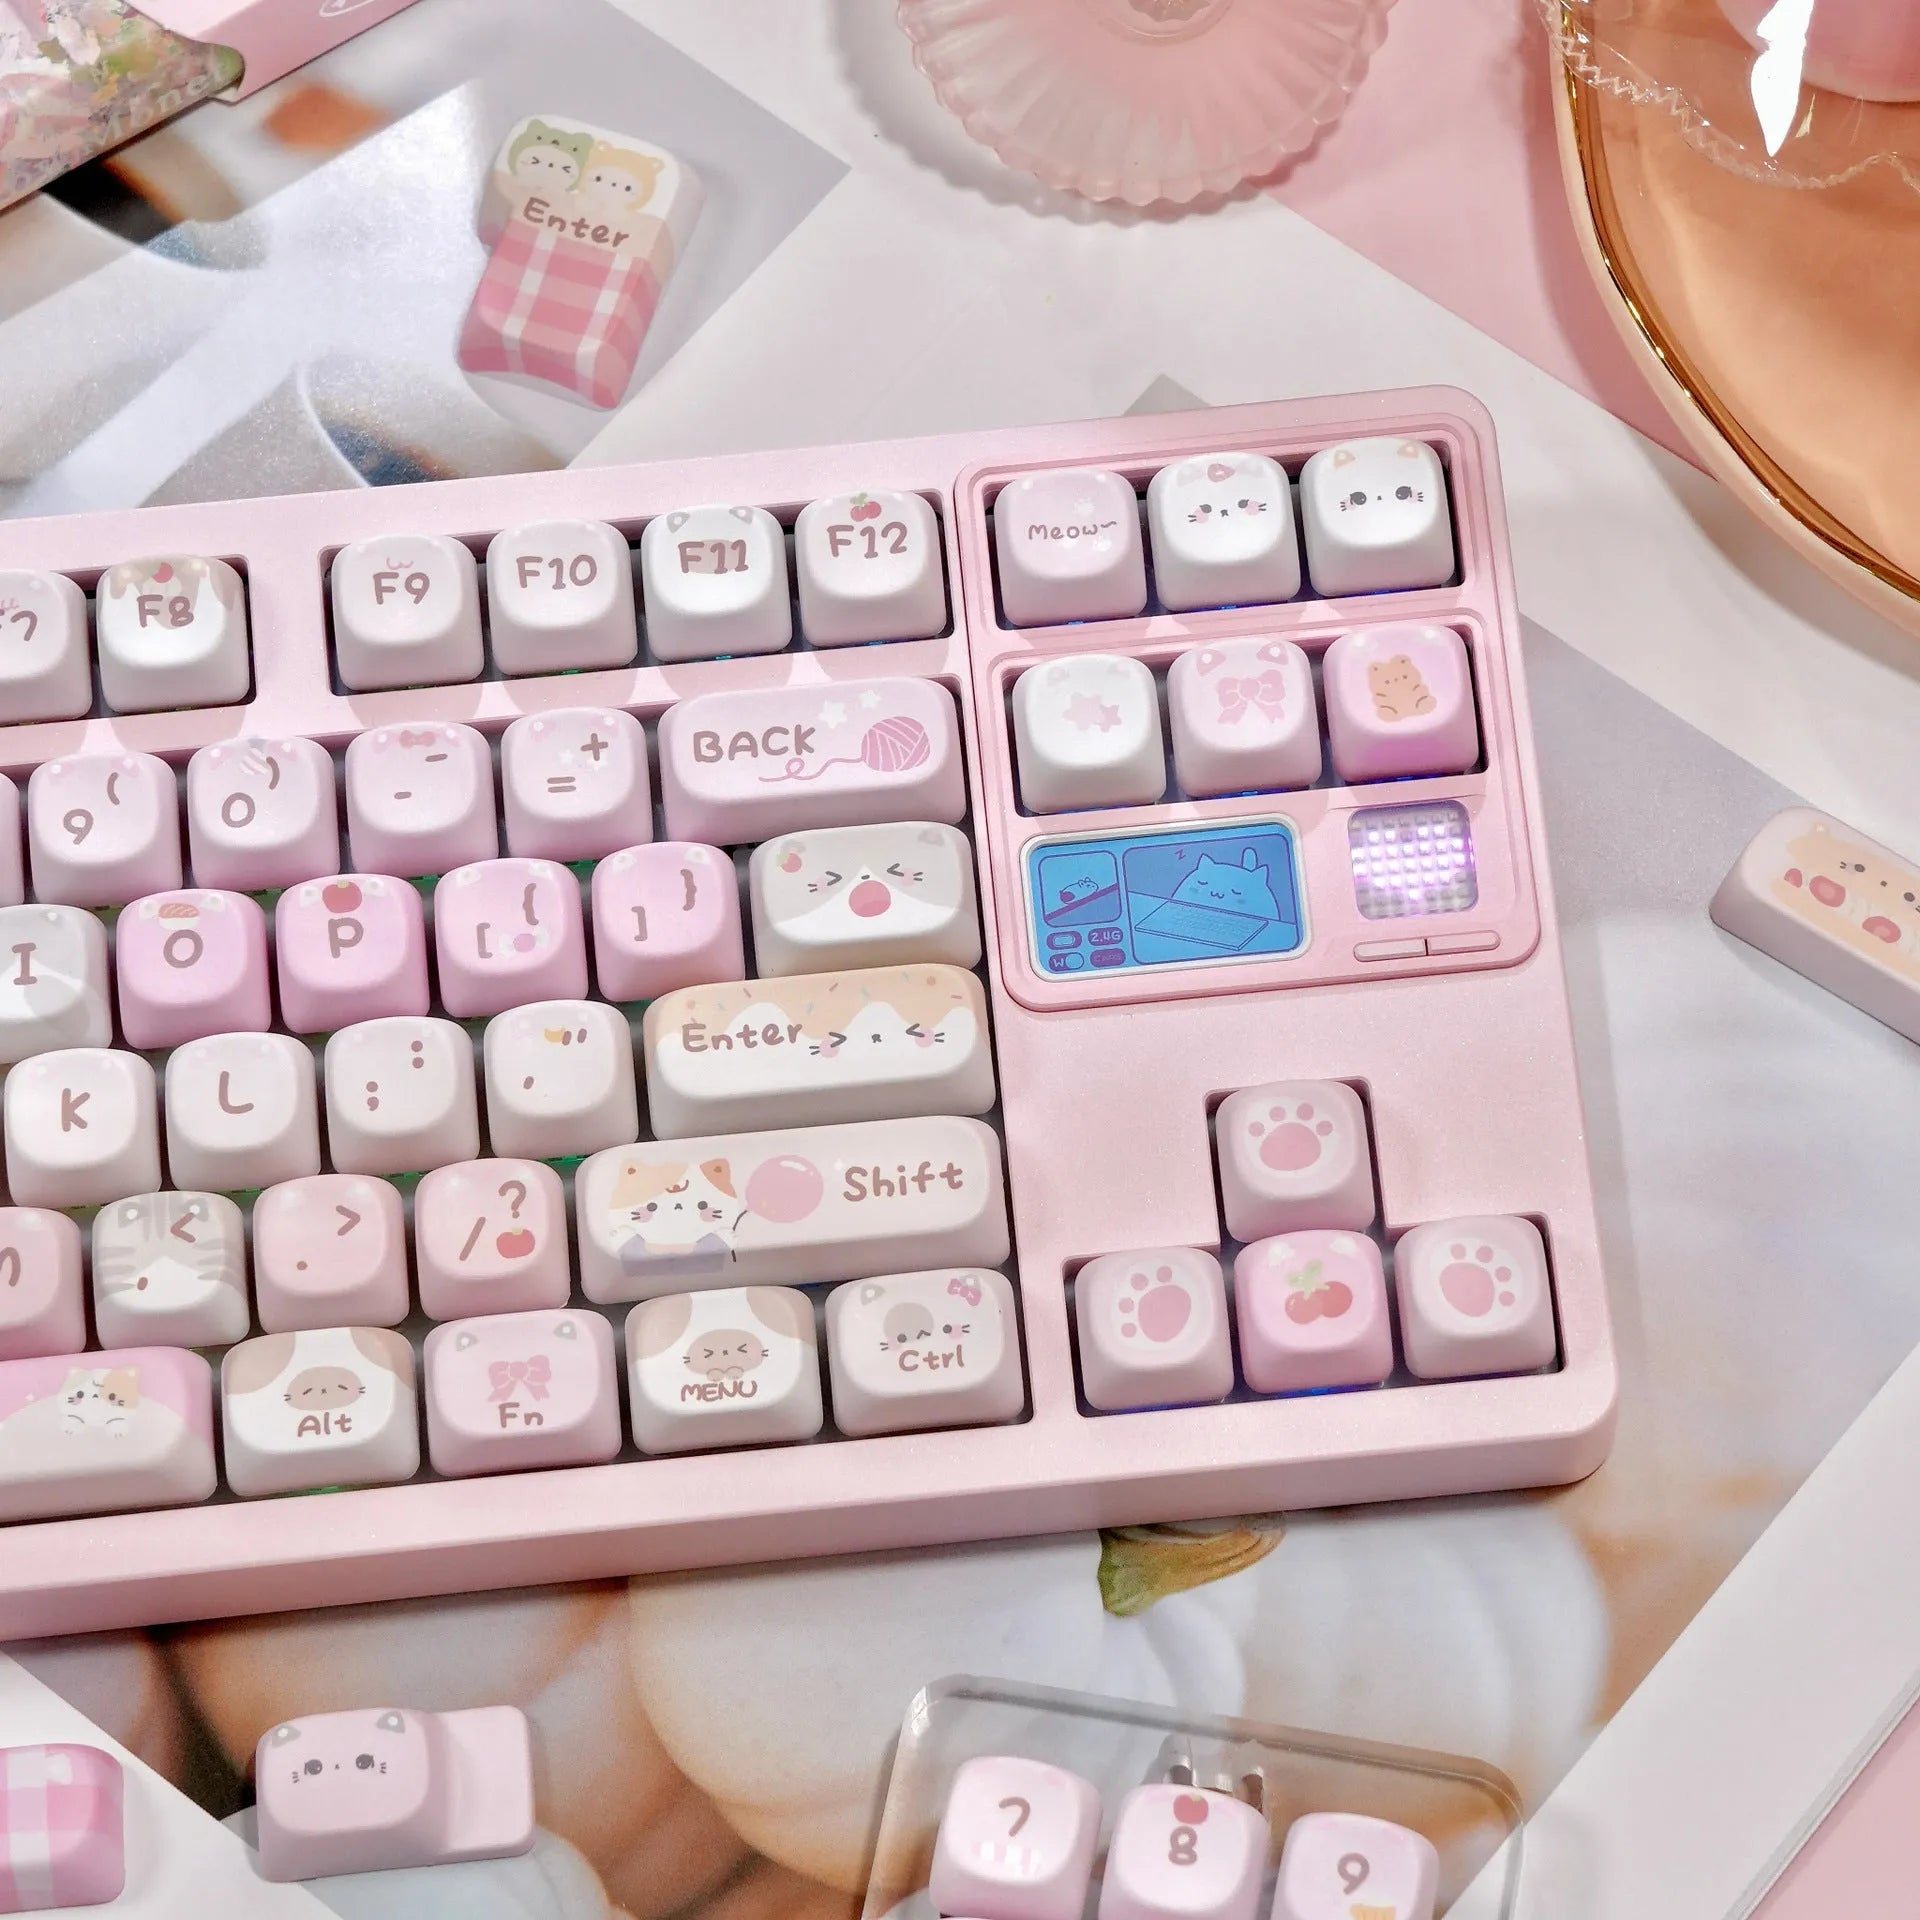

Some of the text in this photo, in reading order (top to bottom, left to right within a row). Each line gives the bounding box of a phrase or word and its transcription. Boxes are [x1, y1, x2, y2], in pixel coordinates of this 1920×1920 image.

[522, 196, 630, 248] Enter
[677, 539, 750, 575] F11
[826, 521, 908, 560] F12
[372, 571, 431, 605] F9
[515, 554, 598, 591] F10
[136, 593, 195, 628] F8
[580, 732, 609, 762] +
[693, 723, 816, 763] BACK
[106, 771, 121, 806] (
[265, 755, 281, 791] )
[546, 776, 577, 794] =
[62, 808, 94, 845] 9
[679, 868, 698, 912] }
[327, 917, 365, 959] P
[476, 922, 494, 959] [
[630, 905, 648, 942] ]
[1090, 930, 1121, 943] 2.4G
[11, 942, 38, 986] I
[162, 929, 204, 969] O
[410, 1040, 425, 1069] :
[681, 1021, 804, 1053] Enter
[61, 1087, 91, 1133] K
[218, 1070, 255, 1115] L
[365, 1080, 380, 1112] ;
[497, 1180, 527, 1219] ?
[842, 1161, 964, 1202] Shift
[169, 1212, 197, 1244] <
[335, 1204, 361, 1237] >
[458, 1216, 487, 1262] /
[898, 1343, 965, 1372] Ctrl
[680, 1380, 758, 1403] MENU
[297, 1411, 353, 1438] Alt
[498, 1401, 544, 1429] Fn
[998, 1796, 1031, 1837] 7
[1168, 1826, 1198, 1866] 8
[1337, 1852, 1370, 1895] 9
